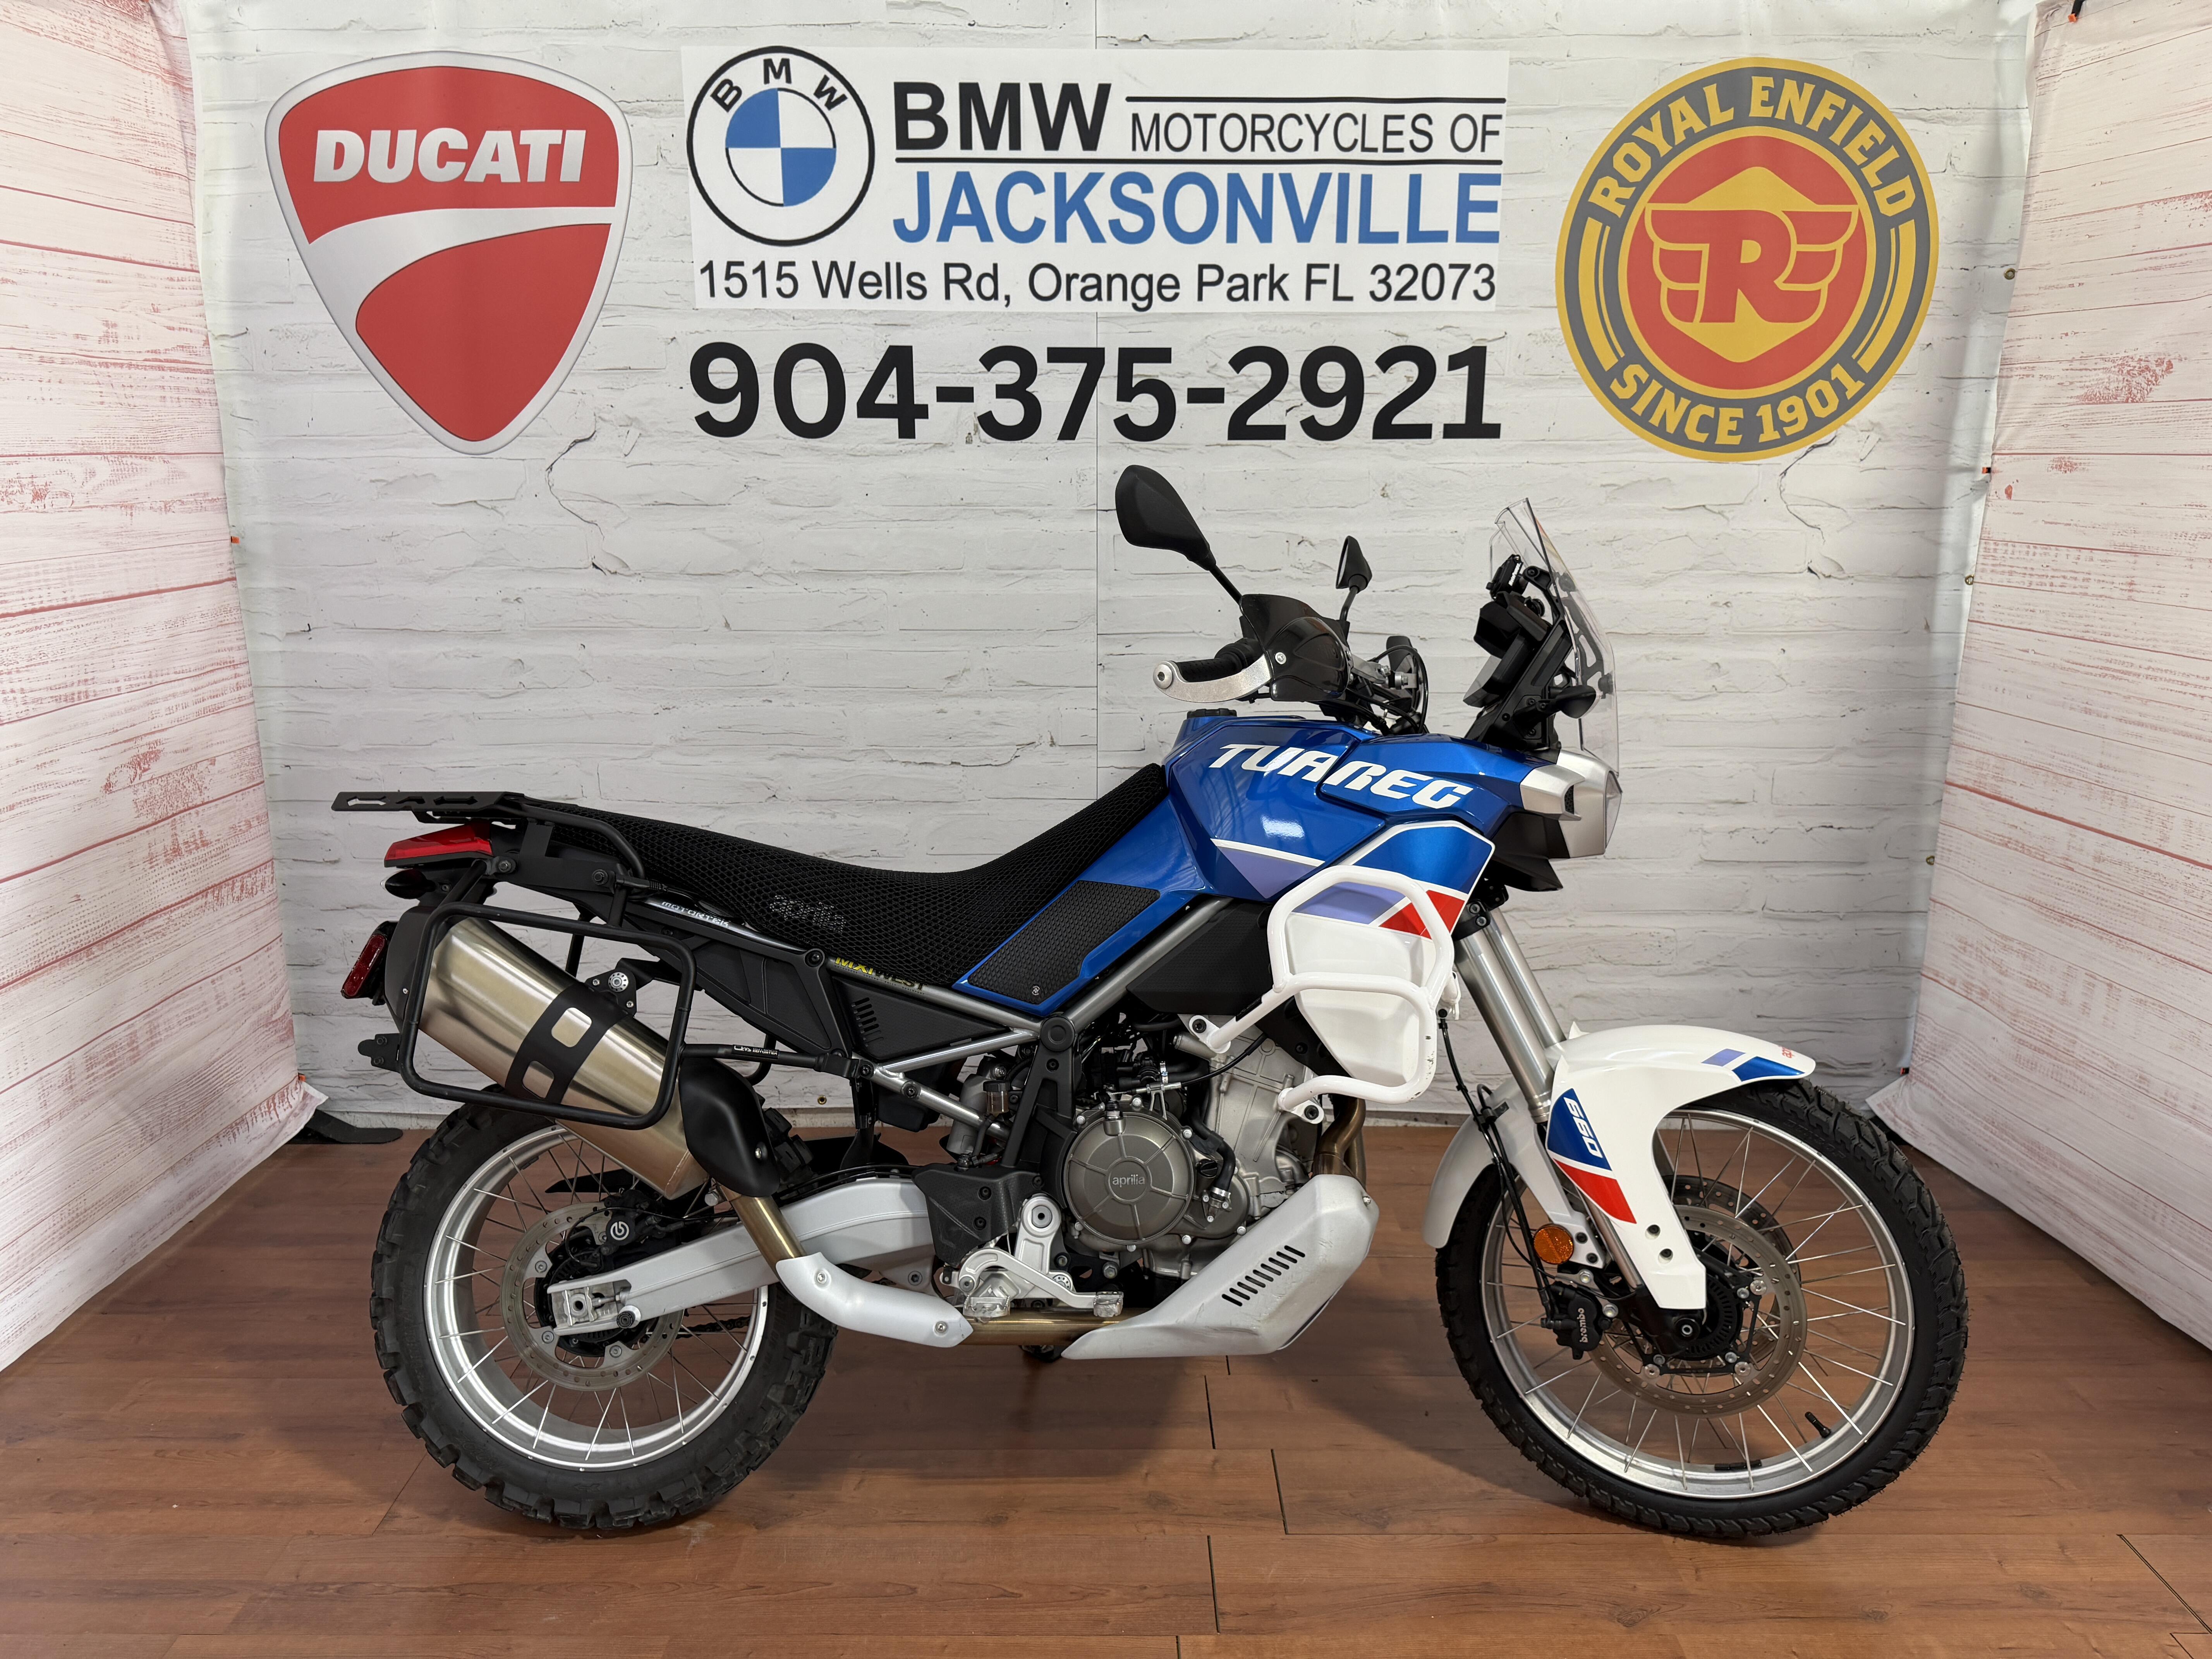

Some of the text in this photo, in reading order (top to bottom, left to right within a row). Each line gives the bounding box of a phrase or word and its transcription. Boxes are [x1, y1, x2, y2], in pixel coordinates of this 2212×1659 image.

[713, 57, 848, 113] BMW
[894, 82, 1502, 153] BMW MOTORCYCLES OF
[1588, 76, 1916, 218] ROYAL ENFIELD
[314, 127, 586, 183] DUCATI
[894, 171, 1501, 244] JACKSONVILLE
[700, 260, 1495, 312] 1515 Wells Rd, Orange Park FL 32073
[690, 342, 1501, 442] 904-375-2921
[1610, 362, 1865, 445] SINCE 1901
[1209, 744, 1473, 809] TUAREG
[1563, 1096, 1603, 1159] 650
[1112, 1174, 1146, 1188] aprilia
[1577, 1307, 1589, 1343] brembo
